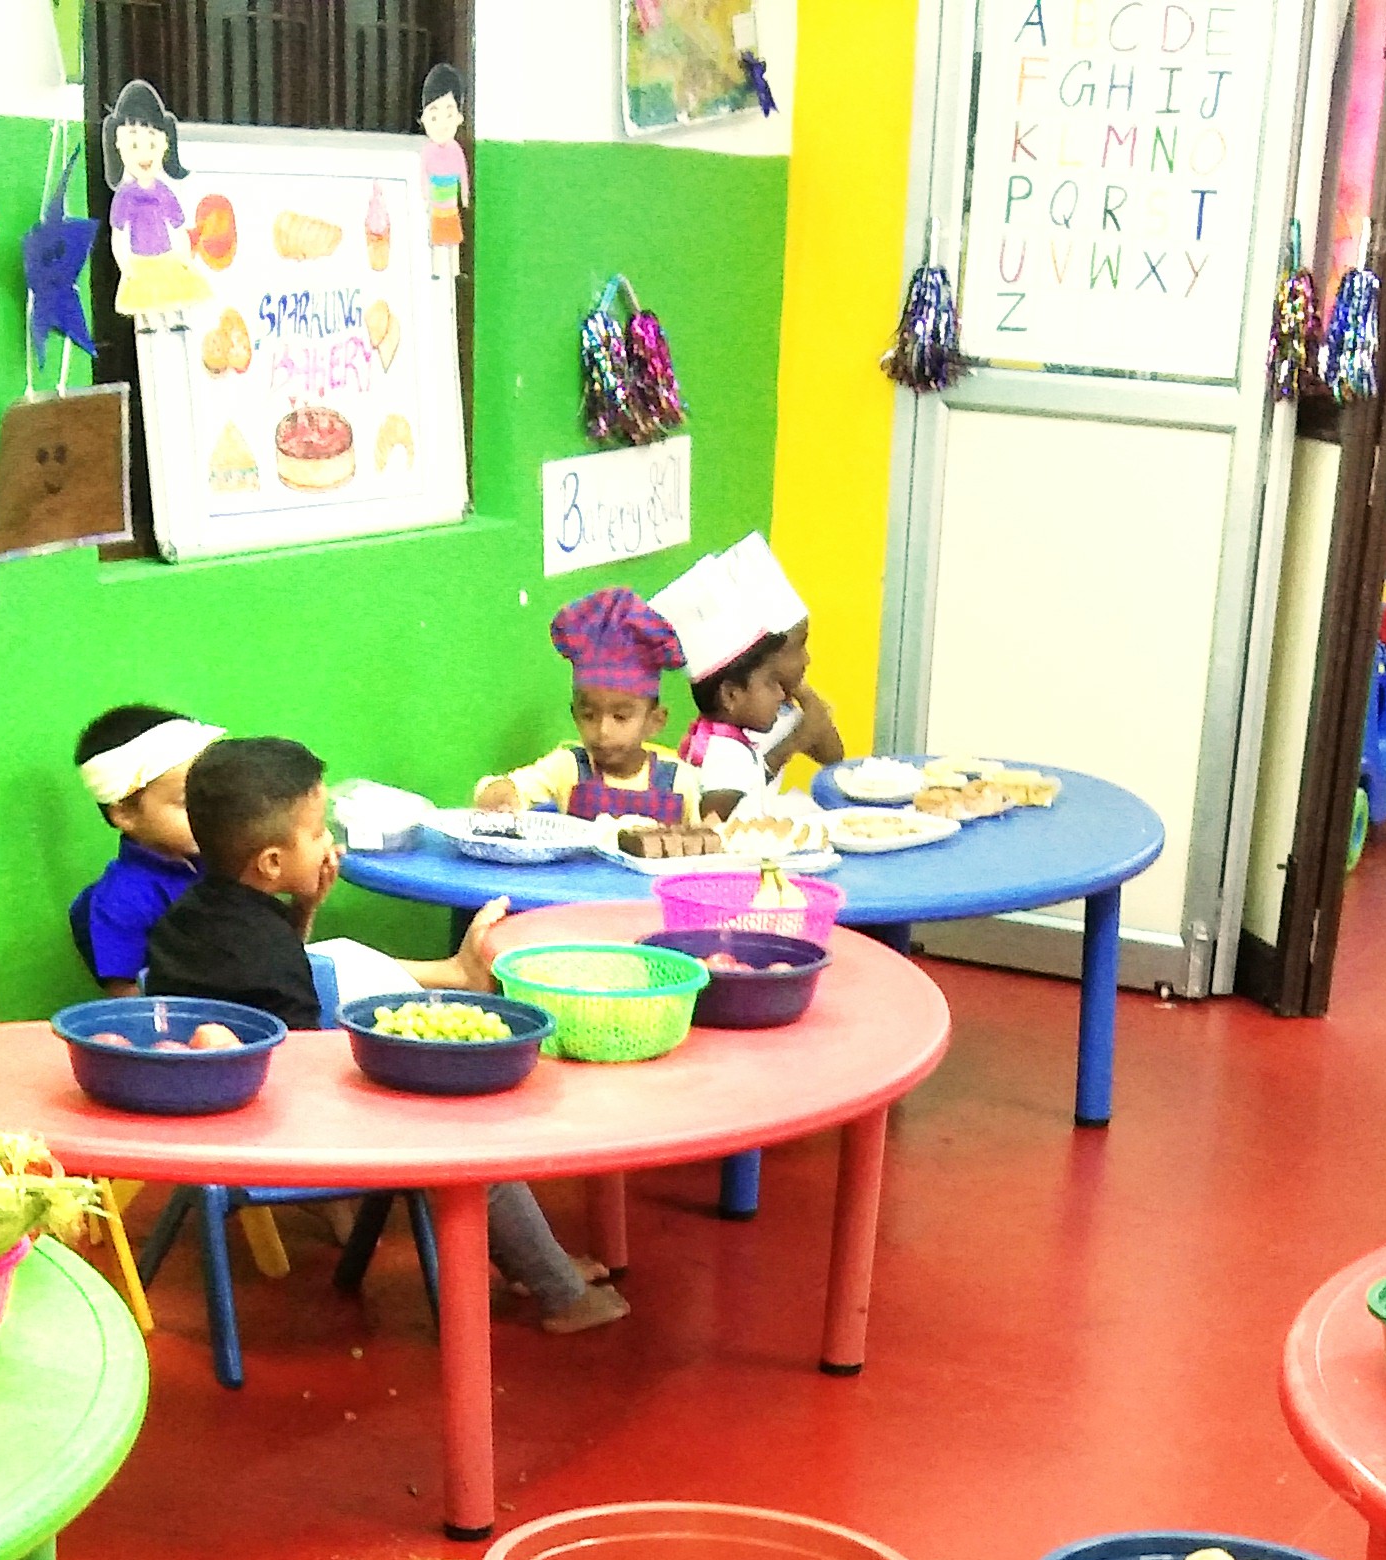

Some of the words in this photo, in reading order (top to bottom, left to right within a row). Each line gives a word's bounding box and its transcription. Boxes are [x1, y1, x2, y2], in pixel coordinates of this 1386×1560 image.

[1014, 0, 1046, 47] A
[1109, 2, 1143, 51] C
[1161, 5, 1195, 53] D
[1205, 8, 1235, 56] E
[1017, 56, 1050, 106] F
[1059, 60, 1096, 107] G
[1106, 63, 1135, 111] H
[1155, 67, 1183, 114] I
[1199, 70, 1233, 119] J
[1011, 121, 1039, 163] K
[1101, 124, 1138, 168] M
[1151, 125, 1178, 174] N
[1004, 175, 1033, 224] P
[1049, 179, 1079, 230] Q
[1102, 185, 1128, 232] R
[1191, 189, 1218, 241] T
[999, 235, 1027, 284] U
[1050, 241, 1072, 285] V
[1089, 242, 1122, 290] W
[1135, 250, 1168, 294] X
[1184, 250, 1210, 298] Y
[996, 292, 1028, 332] Z
